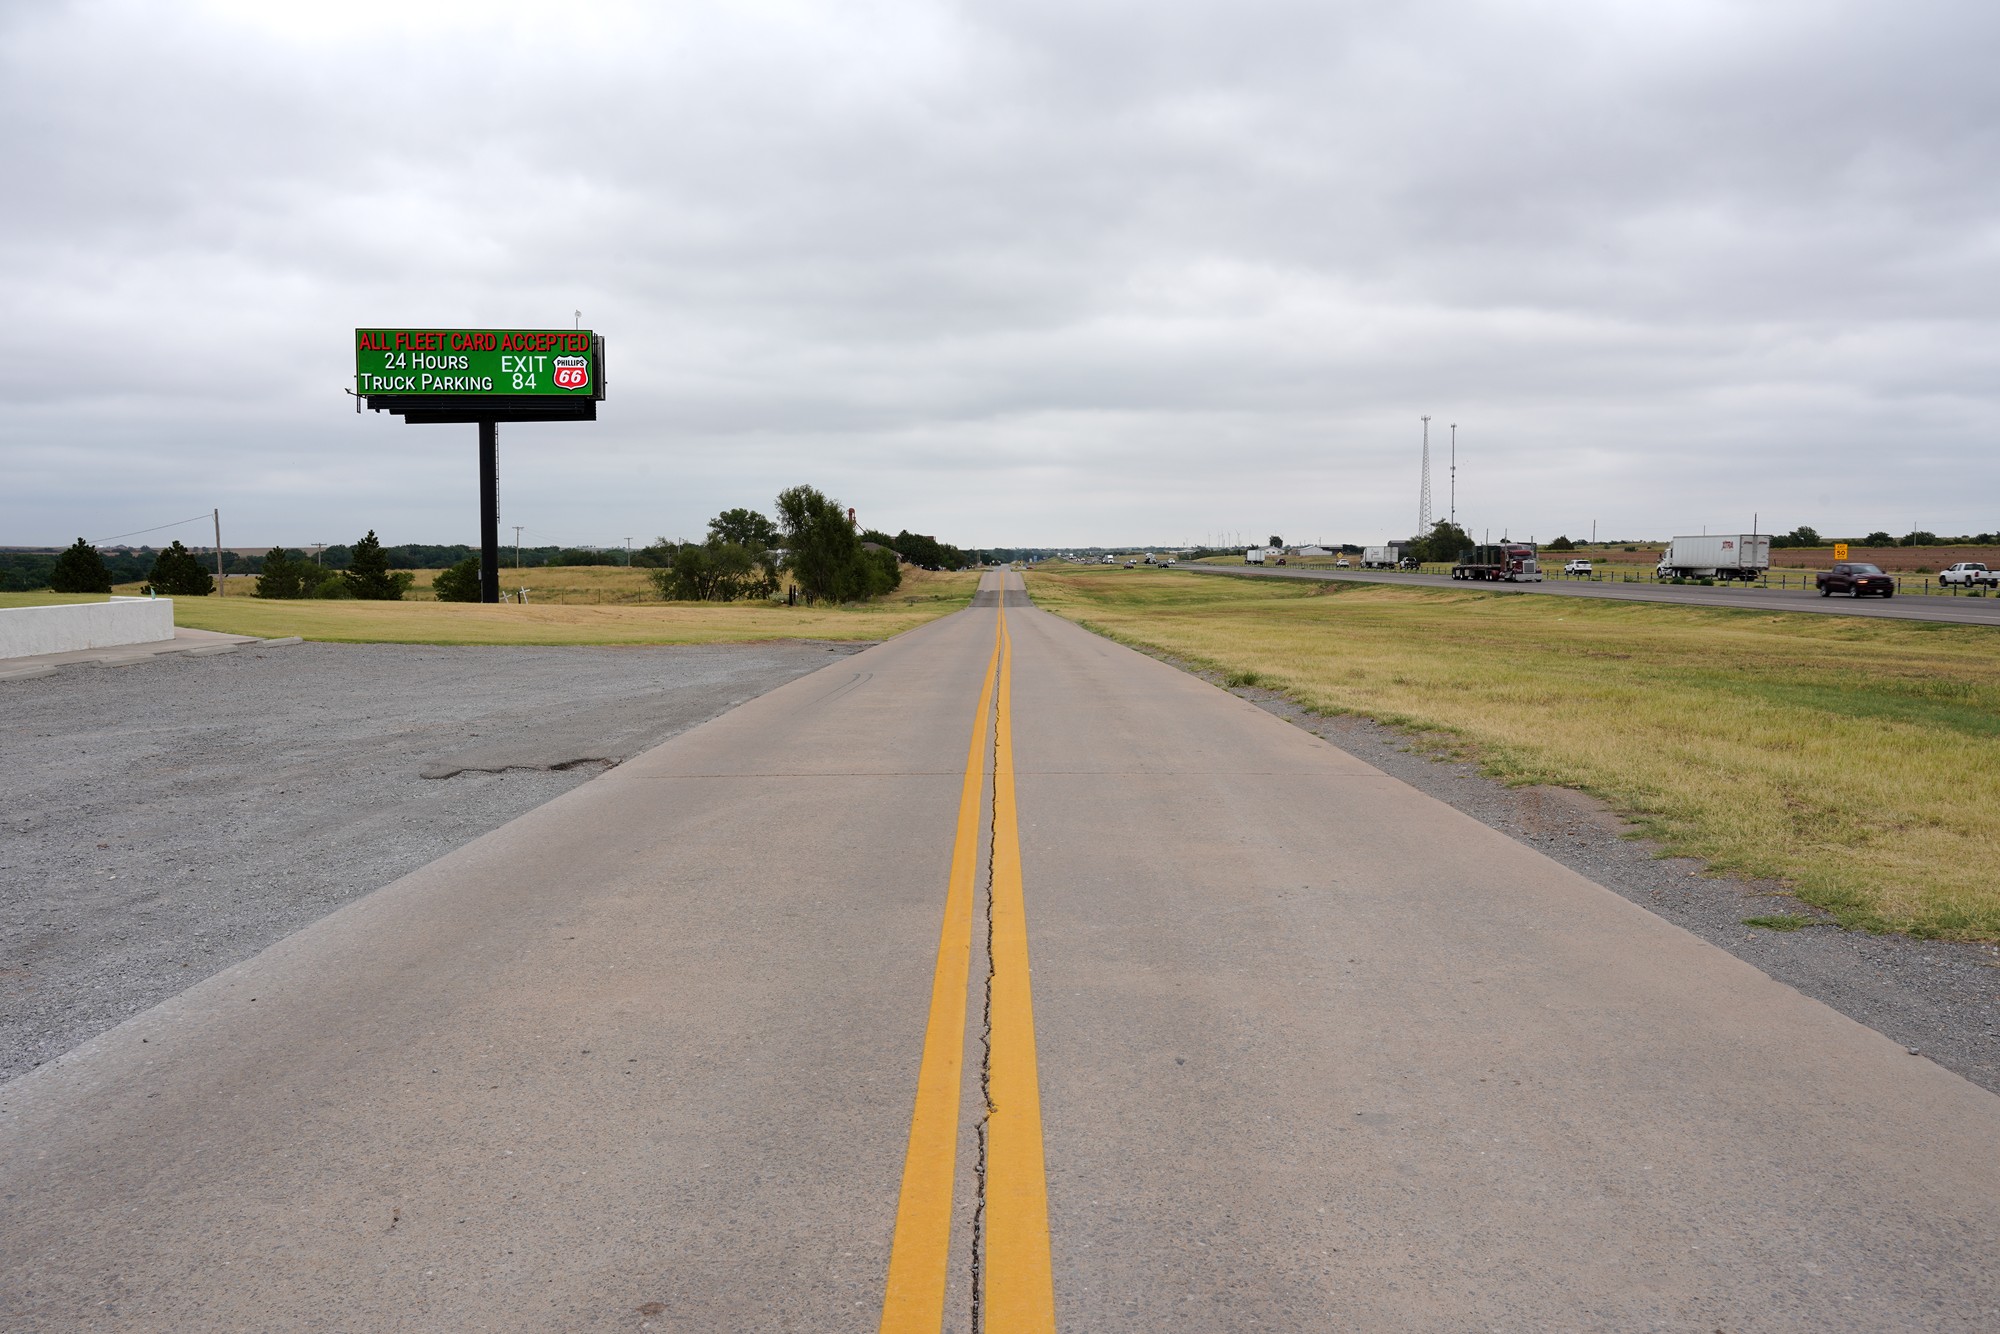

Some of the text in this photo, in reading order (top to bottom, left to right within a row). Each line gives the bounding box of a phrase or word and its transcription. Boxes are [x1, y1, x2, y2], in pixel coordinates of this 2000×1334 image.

[359, 332, 589, 351] ALL FLEET CARD ACCEPTED
[385, 352, 406, 369] 24
[501, 355, 547, 372] EXIT
[512, 373, 537, 390] 84
[559, 370, 582, 383] 66
